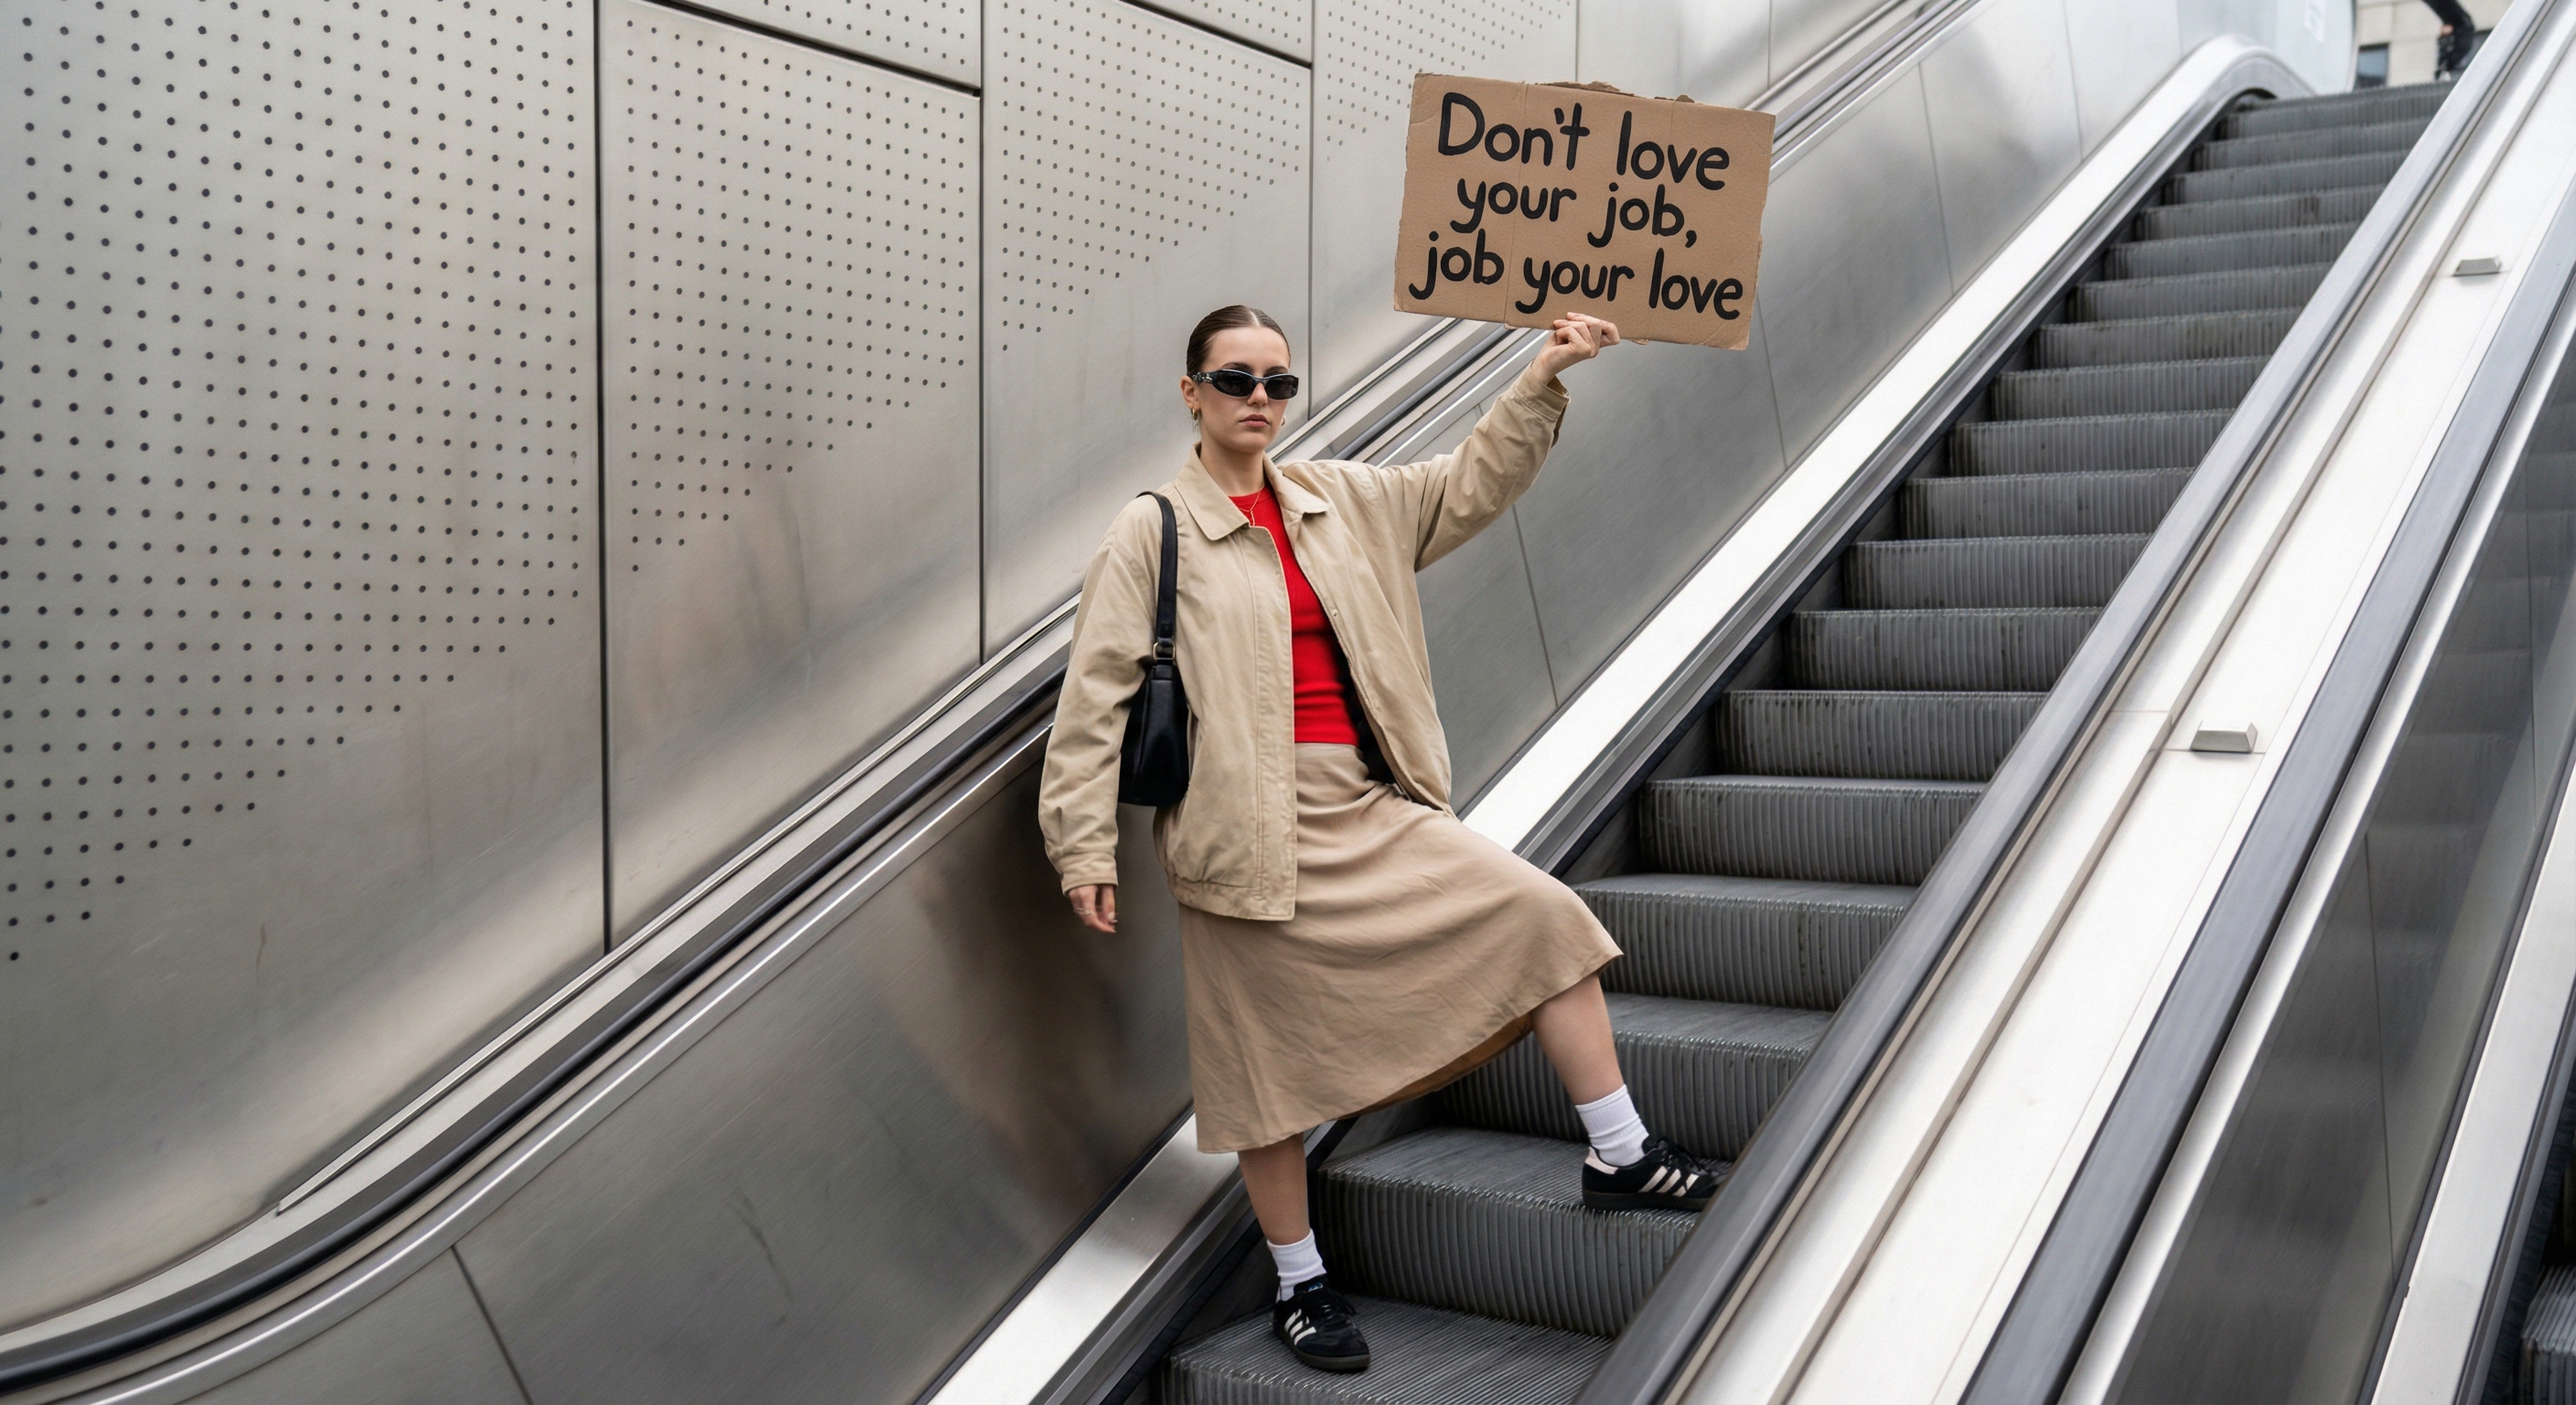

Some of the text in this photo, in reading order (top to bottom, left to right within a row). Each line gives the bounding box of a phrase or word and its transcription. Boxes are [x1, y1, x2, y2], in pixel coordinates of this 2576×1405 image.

[1437, 91, 1730, 191] Don't love
[1449, 177, 1698, 249] your job,
[1408, 228, 1744, 321] job your love
